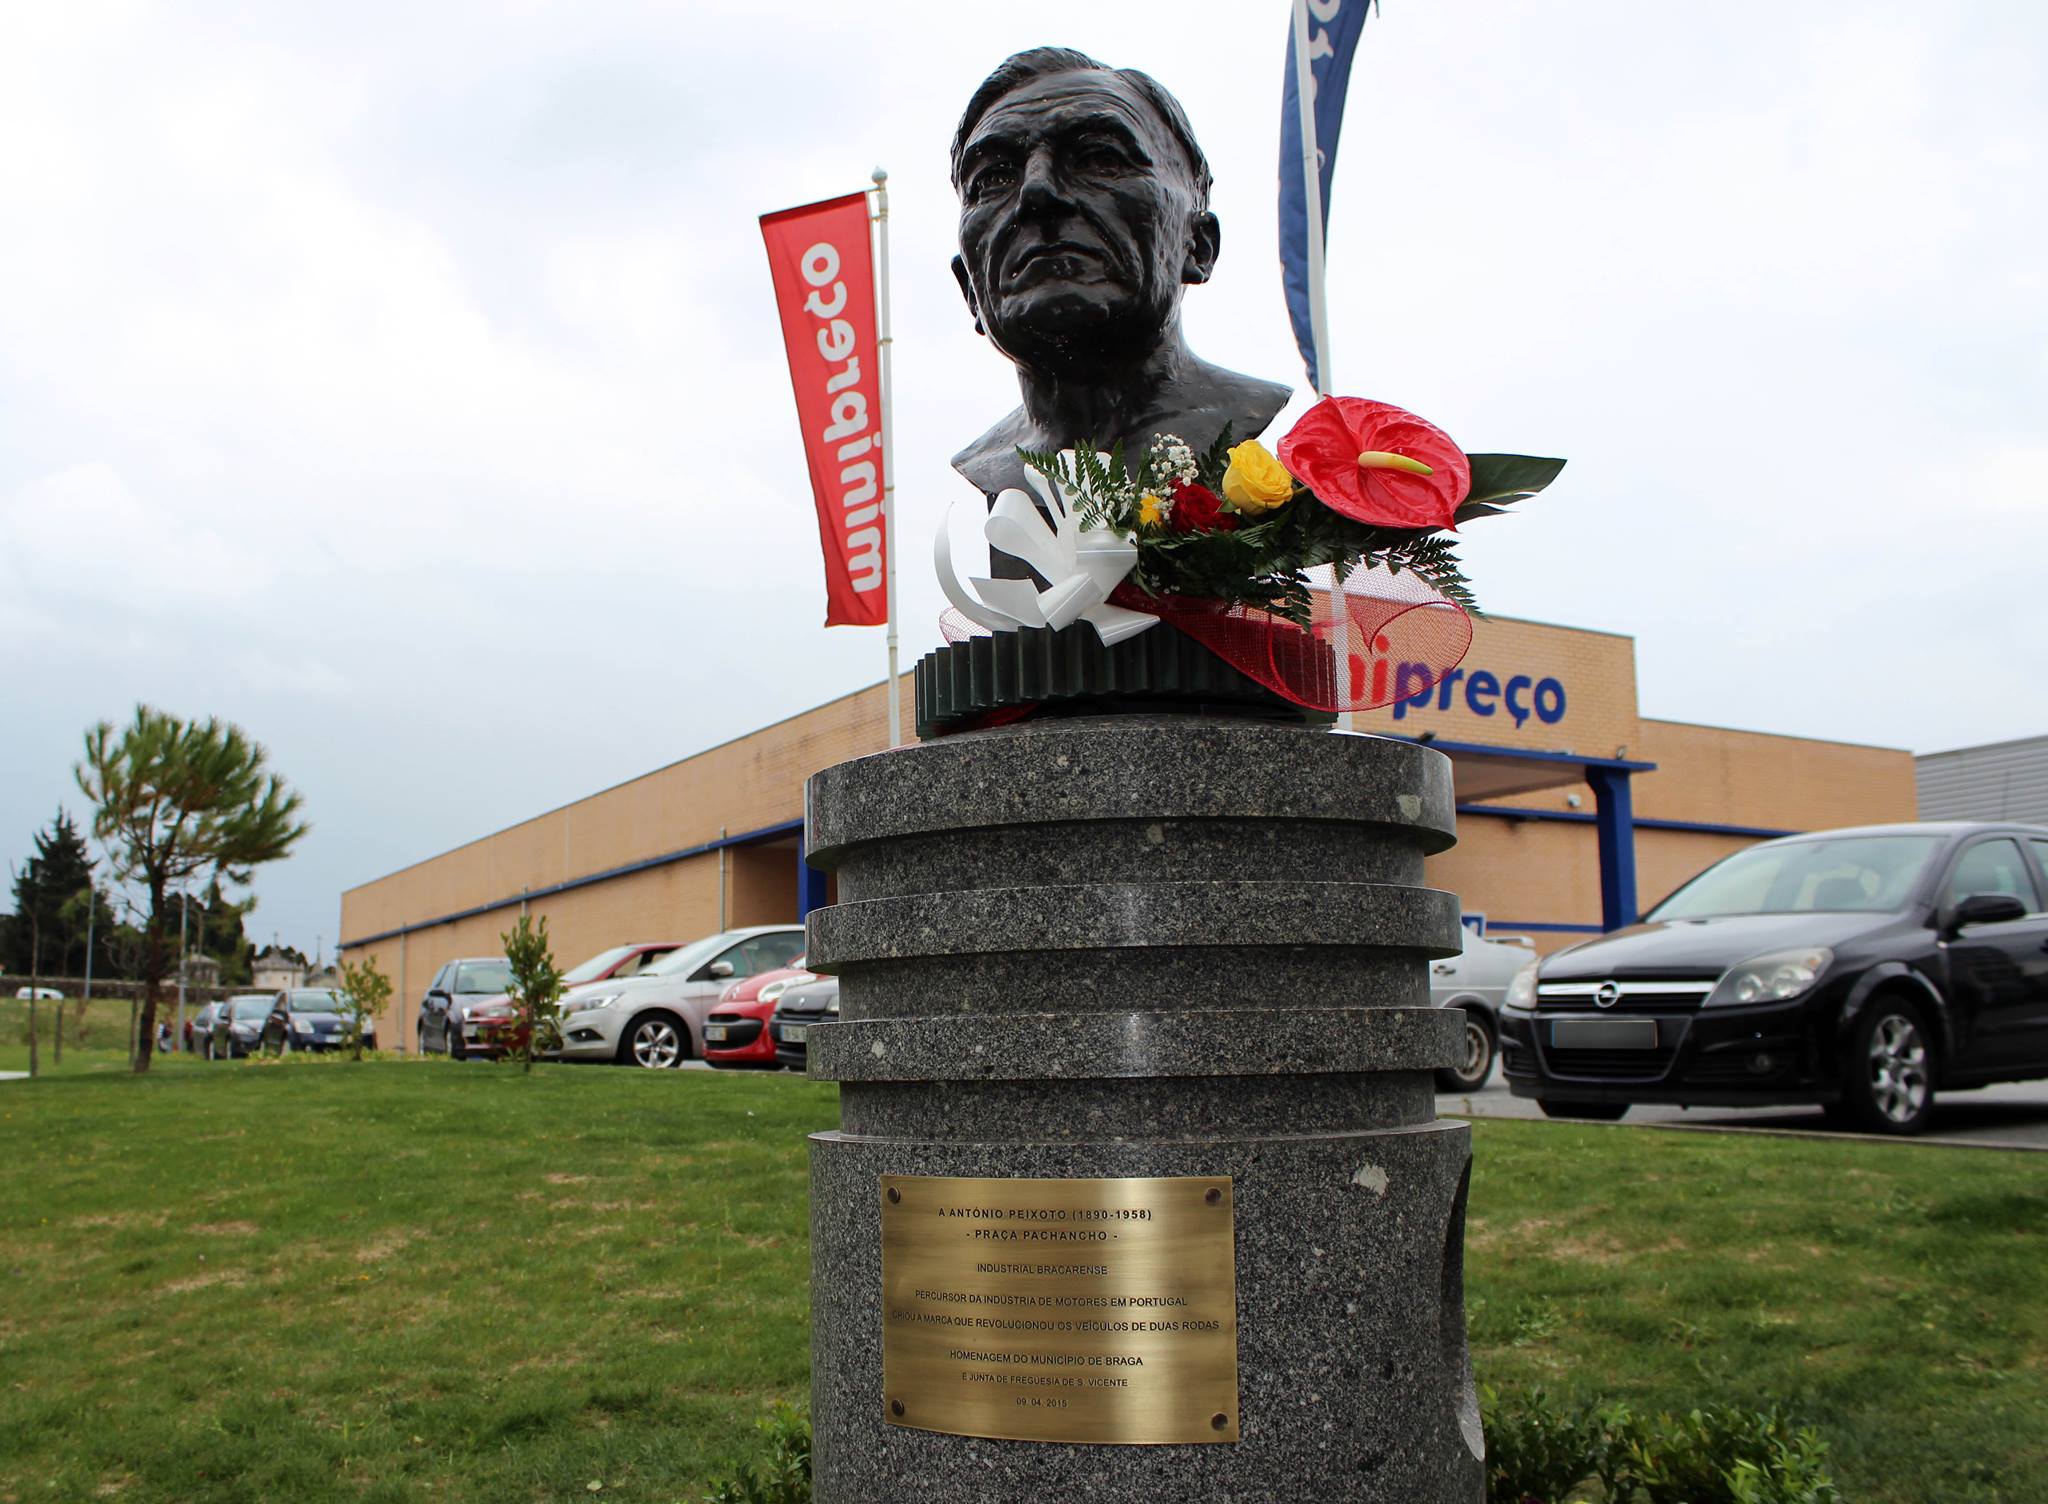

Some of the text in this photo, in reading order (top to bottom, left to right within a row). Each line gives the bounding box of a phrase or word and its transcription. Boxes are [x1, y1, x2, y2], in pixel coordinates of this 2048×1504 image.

[939, 1207, 1152, 1221] A ANTÓNIO PEIXOTO (1890-1958)
[975, 1230, 1018, 1241] PRAÇA
[1023, 1231, 1107, 1241] PACHANCHO
[977, 1264, 1108, 1275] INDUSTRIAL BRACARENSE
[915, 1290, 967, 1303] PERCURSOR
[969, 1295, 981, 1304] DA
[1038, 1298, 1052, 1306] DE
[1055, 1298, 1108, 1307] MOTORES
[1110, 1298, 1126, 1307] EM
[1129, 1298, 1188, 1307] PORTUGAL
[917, 1314, 922, 1323] A
[924, 1315, 953, 1326] MARCA
[954, 1317, 974, 1327] QUE
[976, 1318, 1055, 1331] REVOLUCIONOU
[1057, 1322, 1073, 1331] OS
[1131, 1322, 1147, 1331] DE
[1150, 1321, 1179, 1331] DUAS
[1182, 1320, 1220, 1331] RODAS
[950, 1350, 1144, 1366] HOMENAGEM DO MUNICÍPIO DE BRAGA
[969, 1373, 995, 1383] JUNTA
[996, 1375, 1009, 1384] DE
[1010, 1376, 1061, 1386] FREGUESIA
[1062, 1378, 1075, 1386] DE
[1088, 1378, 1129, 1387] VICENTE
[1046, 1399, 1068, 1408] 2015
